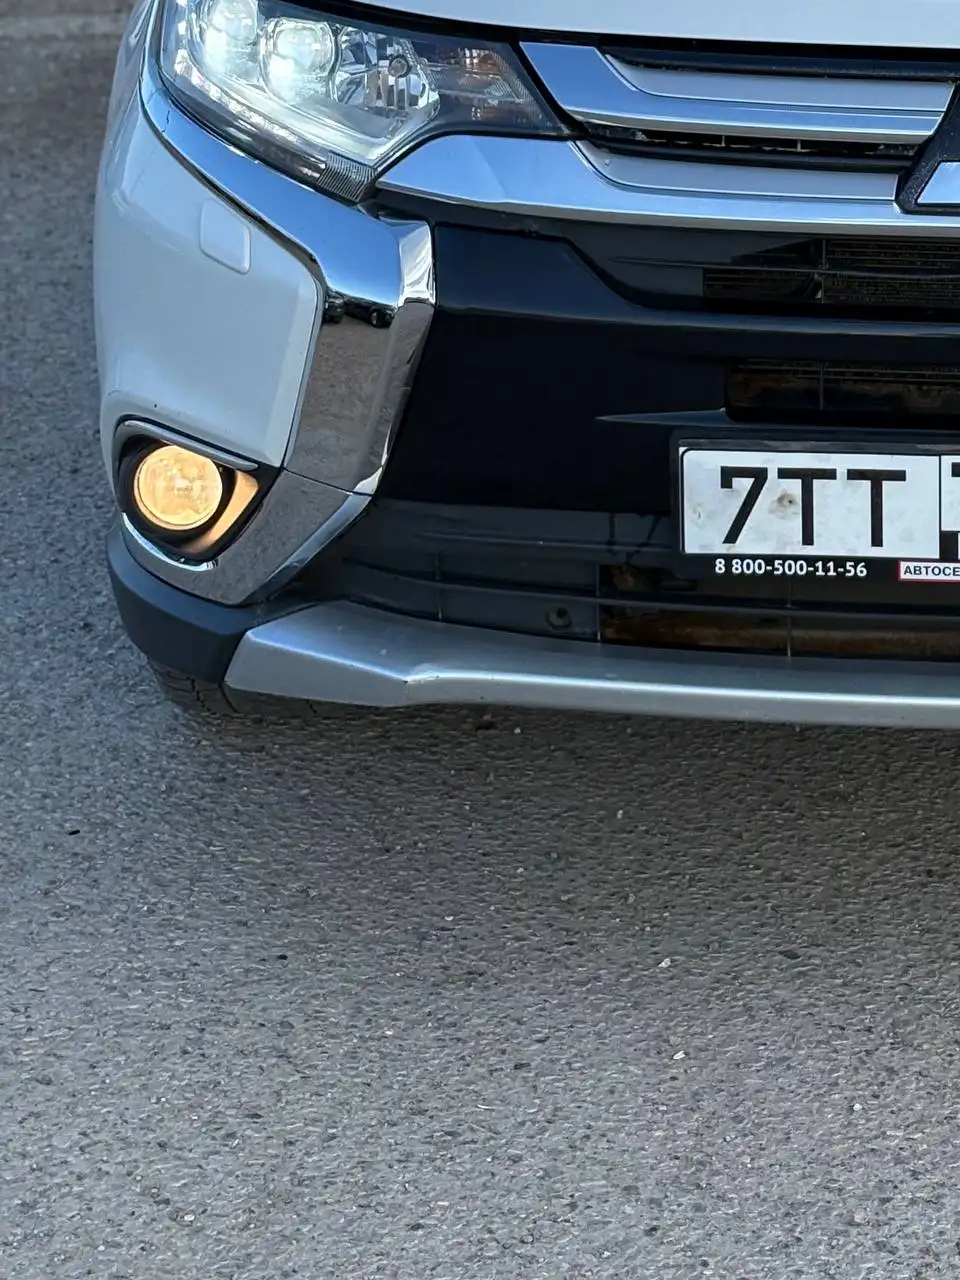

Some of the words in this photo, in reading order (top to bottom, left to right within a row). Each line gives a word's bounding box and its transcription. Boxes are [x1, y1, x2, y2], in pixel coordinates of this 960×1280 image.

[719, 465, 907, 548] 7TT
[714, 559, 726, 574] 8
[731, 559, 867, 578] 800-500-11-56
